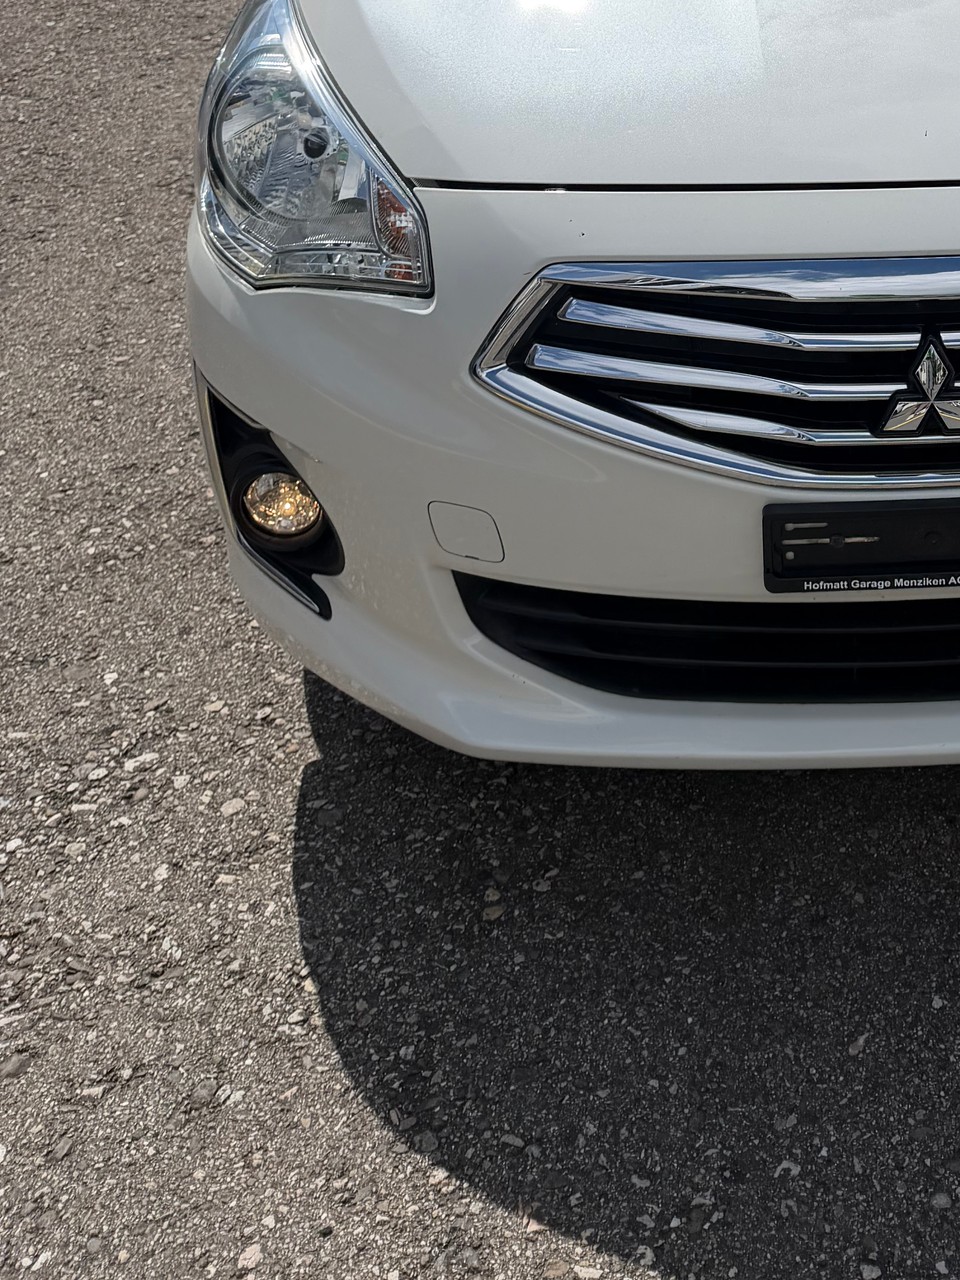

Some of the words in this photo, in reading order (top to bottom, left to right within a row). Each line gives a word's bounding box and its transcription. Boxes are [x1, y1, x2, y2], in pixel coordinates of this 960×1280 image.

[804, 581, 848, 590] Hofmatt
[851, 580, 891, 589] Garage
[894, 577, 946, 587] Menziken
